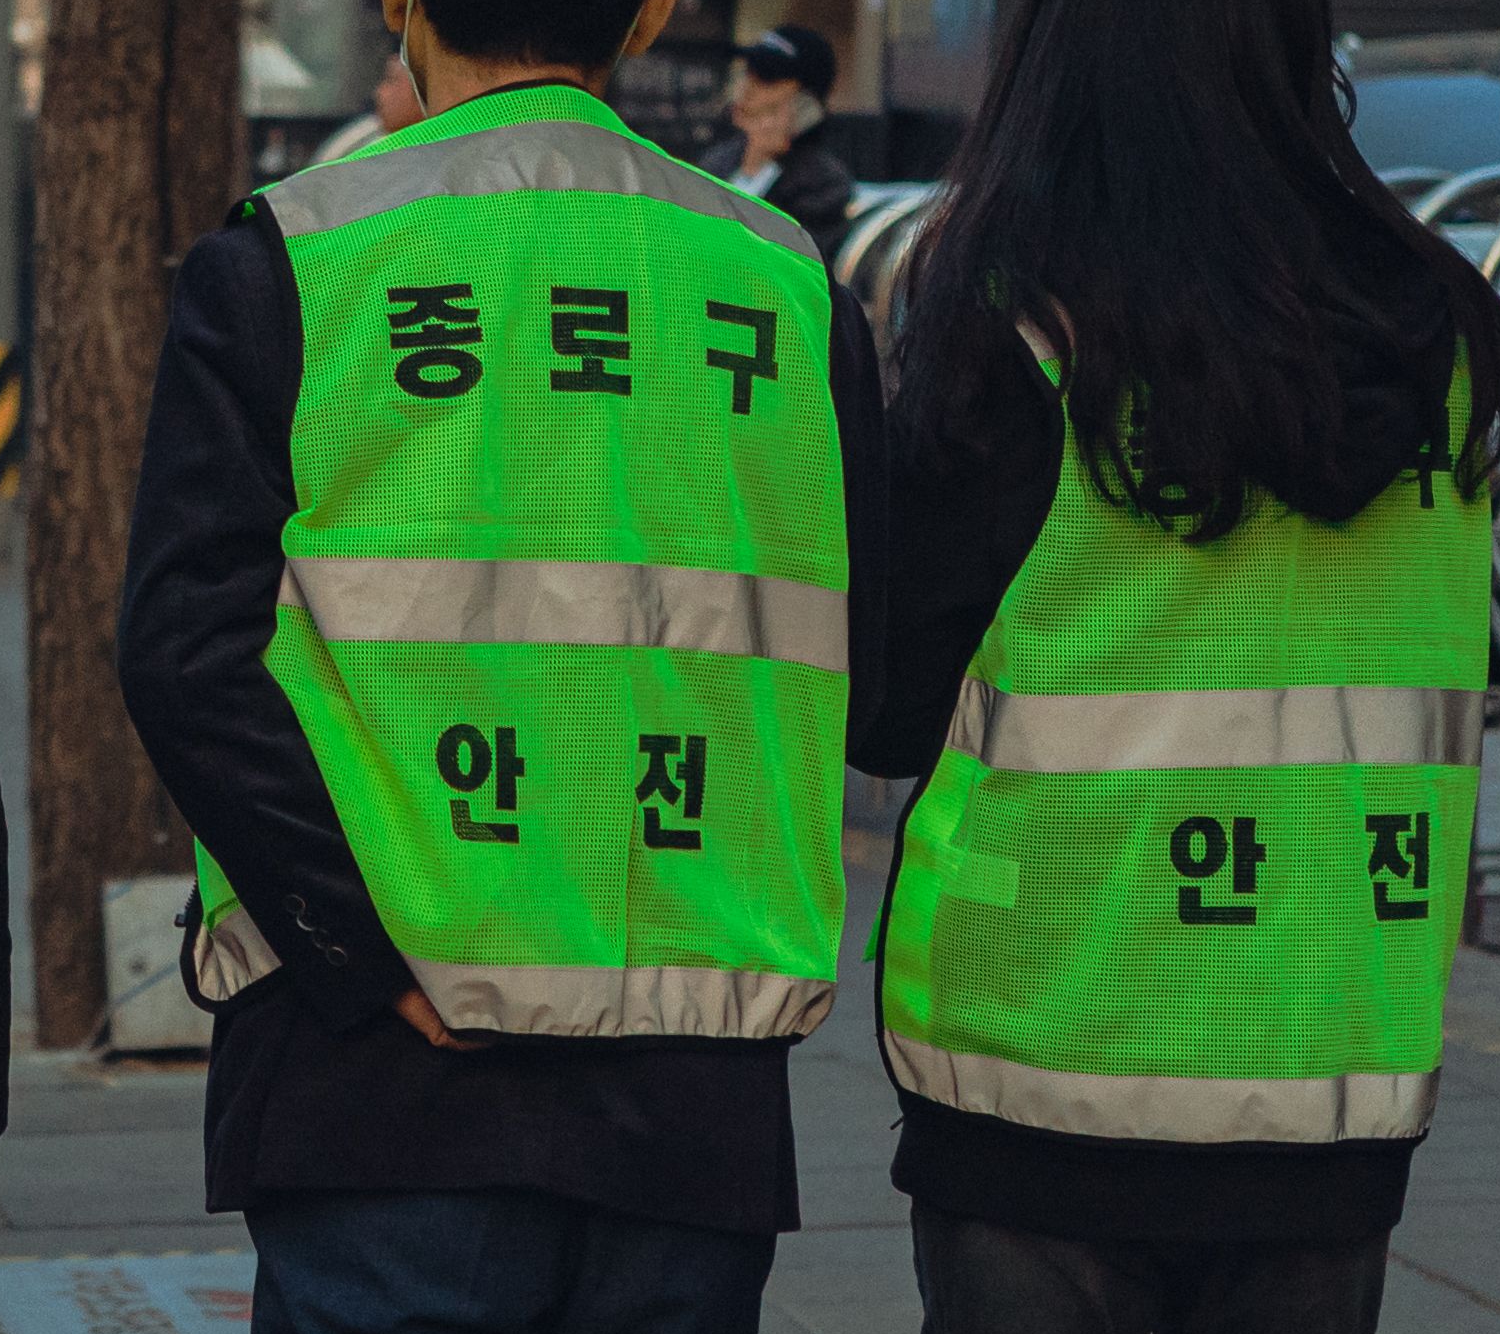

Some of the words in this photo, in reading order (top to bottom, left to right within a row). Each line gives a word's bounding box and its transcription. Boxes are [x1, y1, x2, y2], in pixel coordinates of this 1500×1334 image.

[387, 282, 779, 415] 종로구
[435, 722, 708, 851] 안전
[1169, 811, 1430, 925] 안전
